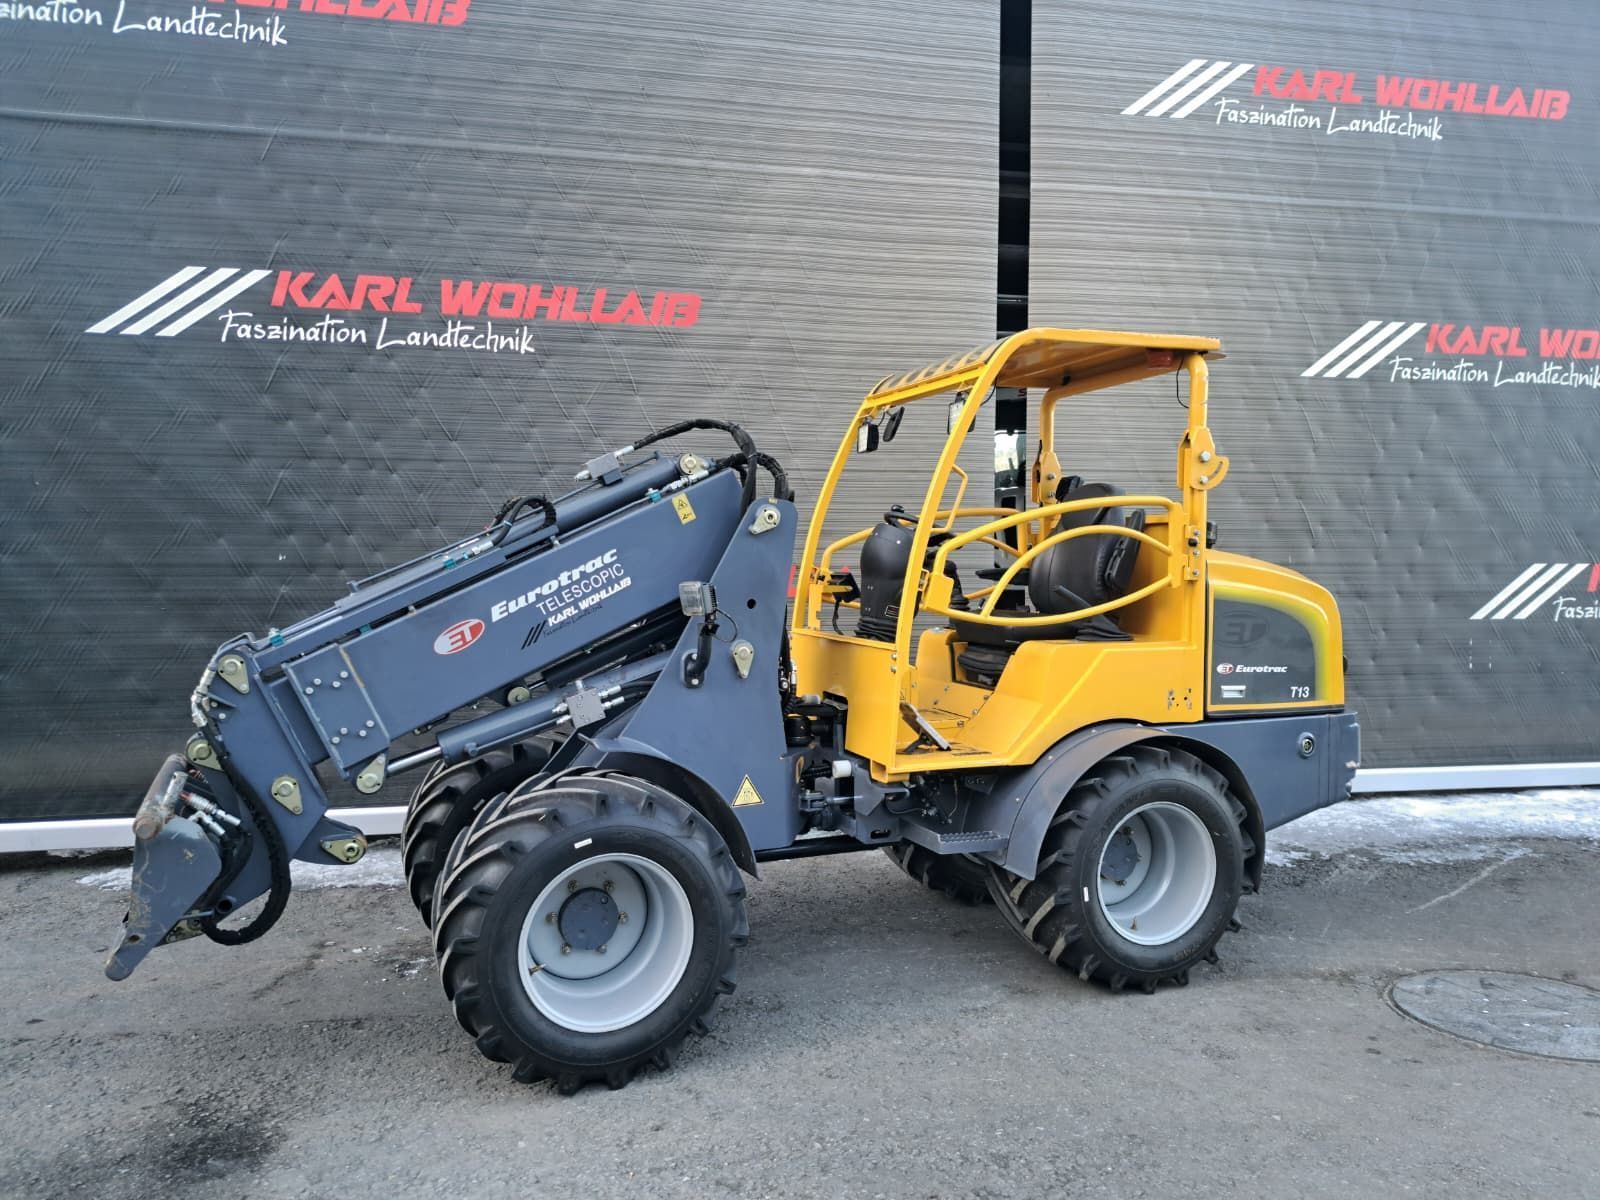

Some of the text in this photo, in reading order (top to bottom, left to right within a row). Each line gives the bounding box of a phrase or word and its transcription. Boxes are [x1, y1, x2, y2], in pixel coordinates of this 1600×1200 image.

[113, 0, 288, 46] Landtechnik
[1253, 65, 1363, 104] KARL
[1214, 97, 1443, 141] Faszination Landtechnik
[270, 270, 423, 313] KARL
[218, 309, 536, 355] Faszination Landtechnik
[1425, 323, 1600, 359] KARL WO
[1388, 355, 1489, 382] Faszination
[490, 548, 618, 623] Eurotrac
[535, 563, 625, 615] TELESCOPIC
[548, 605, 579, 627] KARL
[1552, 596, 1600, 622] Faszi
[1235, 664, 1289, 673] Eurotrac
[1290, 686, 1310, 698] T13
